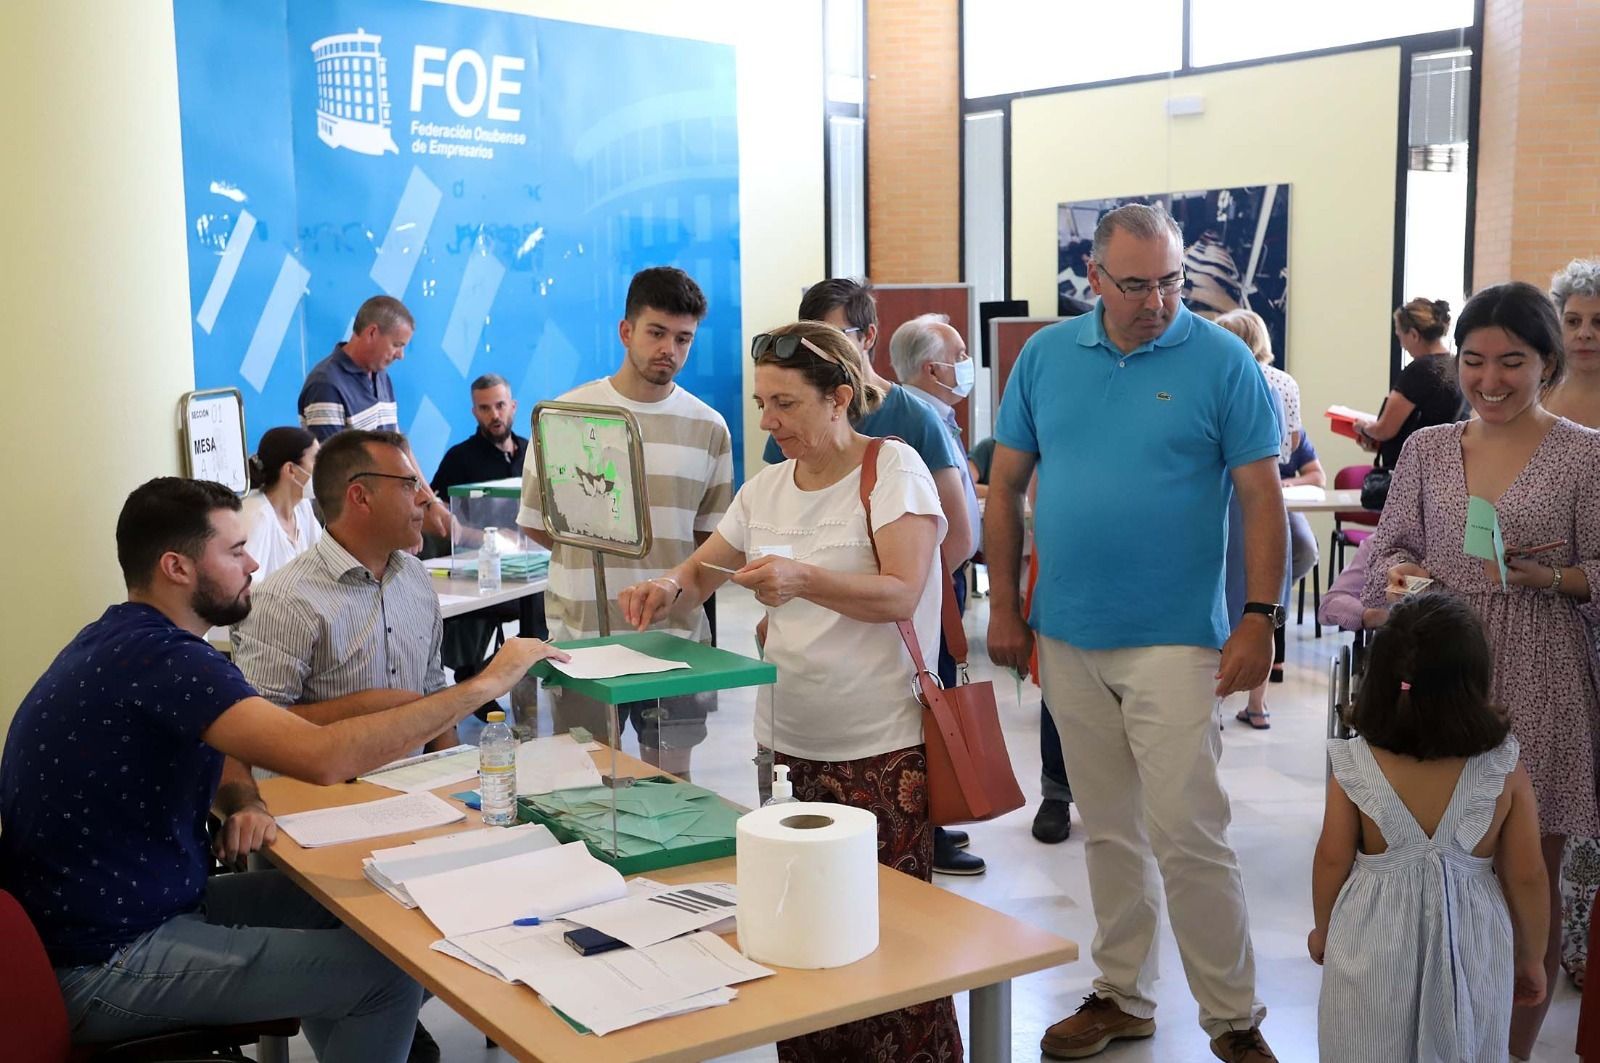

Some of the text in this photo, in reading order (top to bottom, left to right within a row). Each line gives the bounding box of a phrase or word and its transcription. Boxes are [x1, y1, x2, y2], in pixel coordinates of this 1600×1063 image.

[410, 45, 525, 121] FOE
[411, 120, 526, 144] Federación Onubense
[411, 138, 493, 159] de Empresarios
[194, 437, 216, 455] MESA
